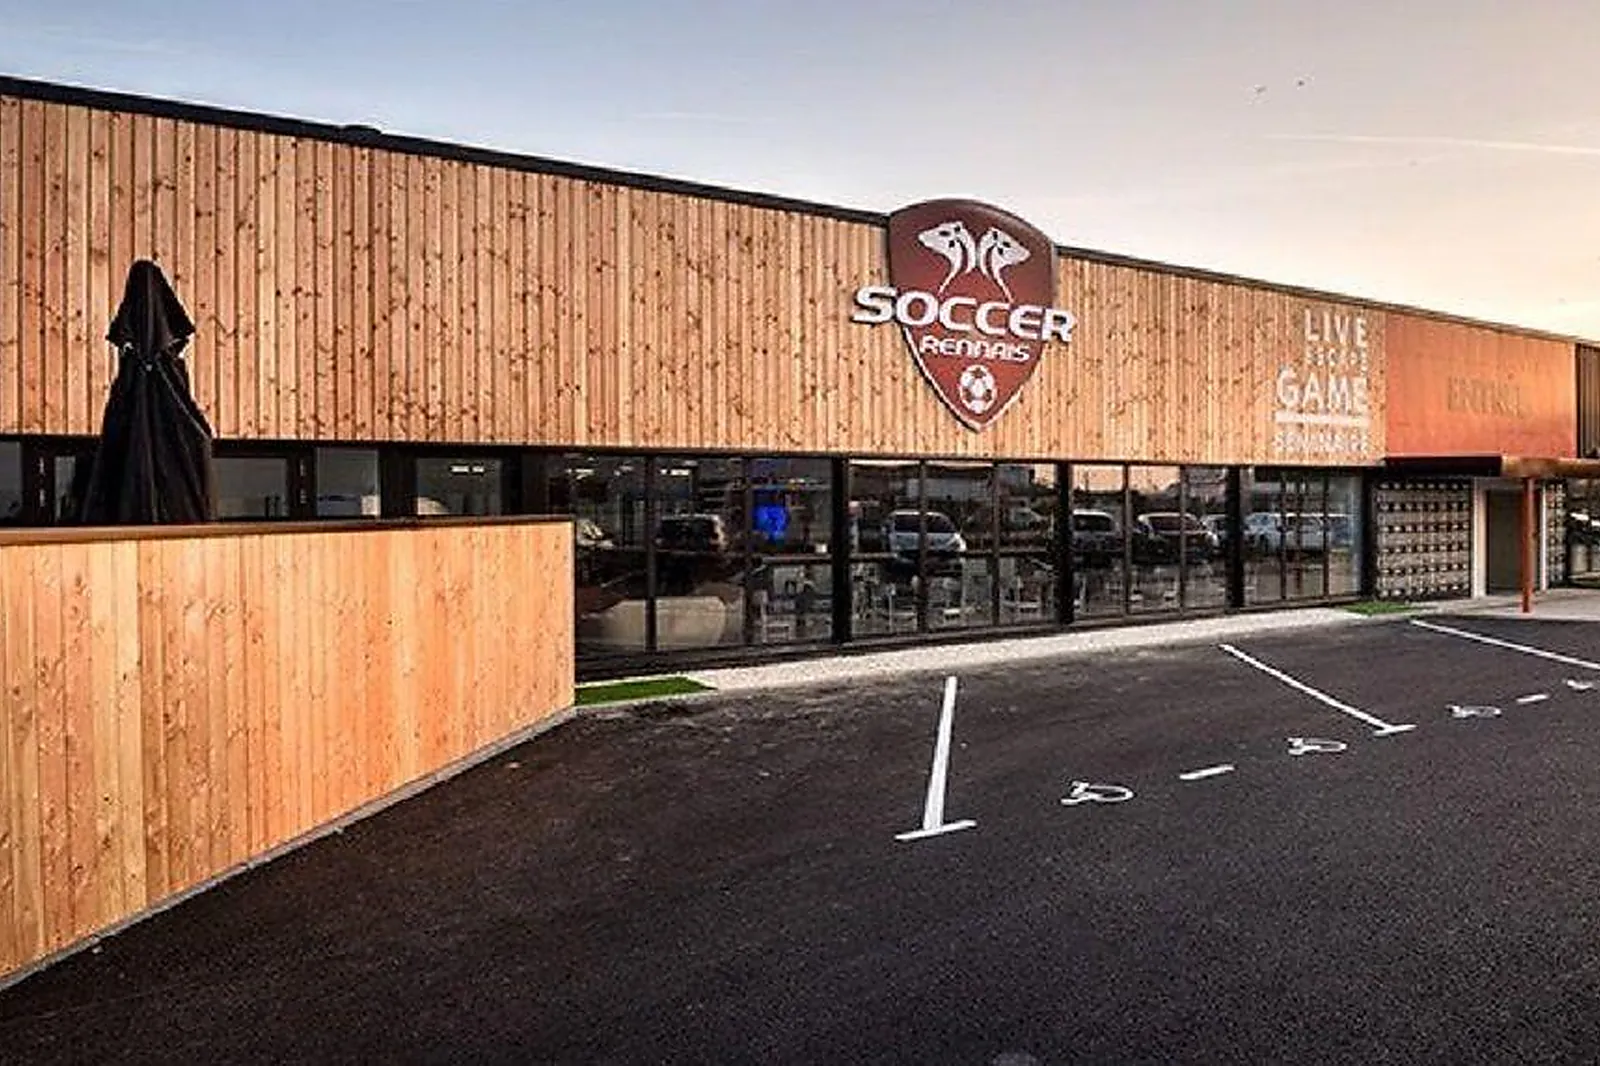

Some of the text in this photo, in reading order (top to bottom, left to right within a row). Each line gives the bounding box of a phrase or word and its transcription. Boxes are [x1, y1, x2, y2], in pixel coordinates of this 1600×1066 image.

[852, 285, 1076, 343] SOCCER
[1304, 308, 1368, 347] LIVE
[1276, 367, 1369, 414] GAME
